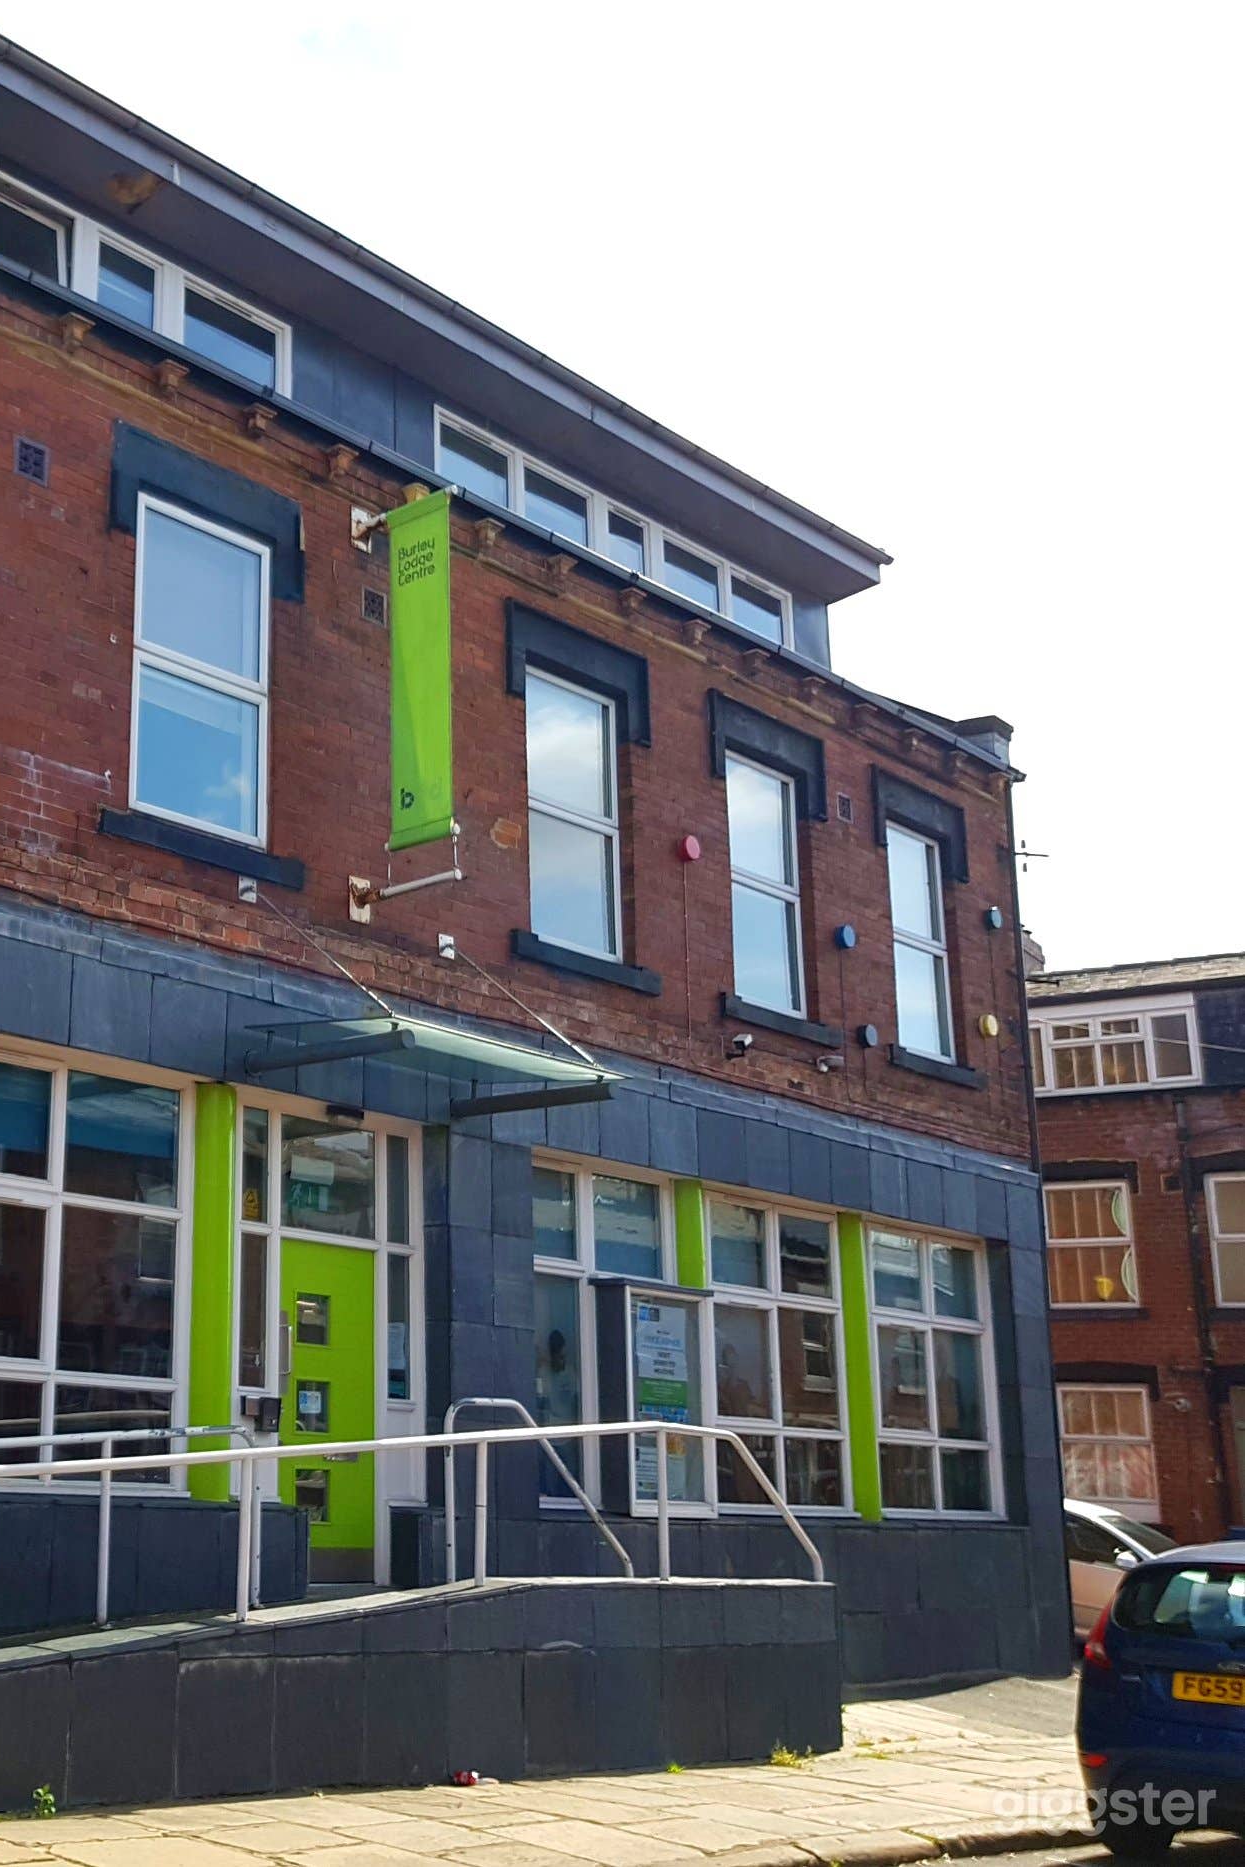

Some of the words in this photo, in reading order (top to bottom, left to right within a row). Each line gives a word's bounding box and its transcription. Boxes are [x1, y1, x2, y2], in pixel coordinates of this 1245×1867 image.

[398, 537, 435, 560] Burley
[398, 551, 434, 574] Lodge
[398, 564, 435, 587] Centre
[1183, 1676, 1243, 1701] FG59
